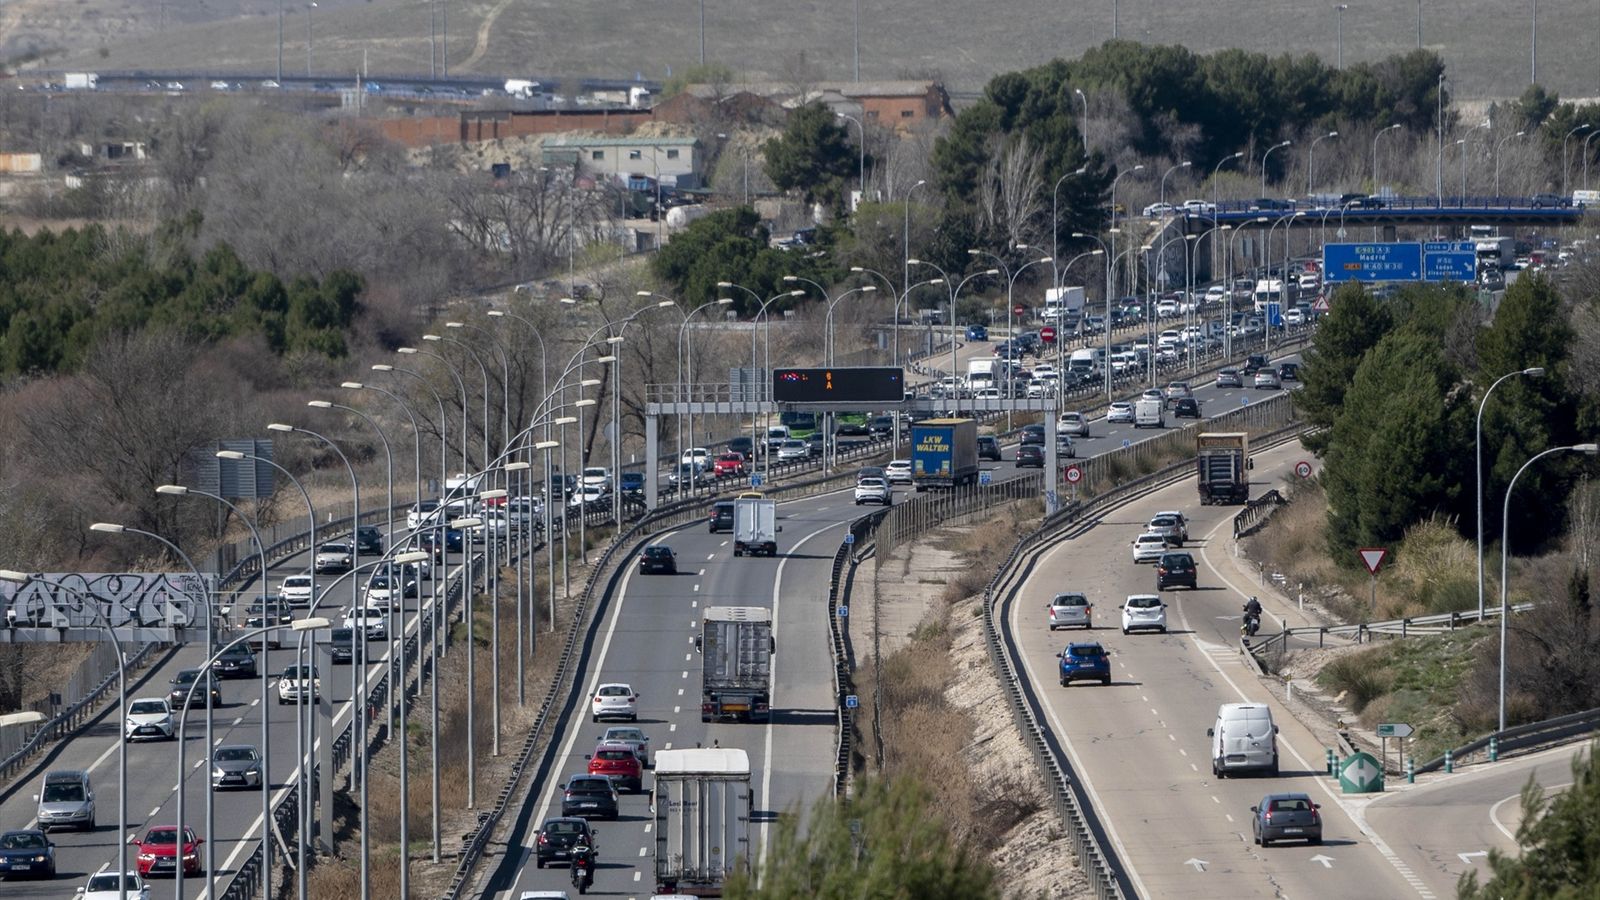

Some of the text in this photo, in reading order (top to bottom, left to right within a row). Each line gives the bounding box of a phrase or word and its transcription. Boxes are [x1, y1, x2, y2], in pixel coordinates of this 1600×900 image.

[923, 436, 942, 444] LKW
[916, 444, 949, 452] WALTER
[1298, 466, 1308, 474] 60
